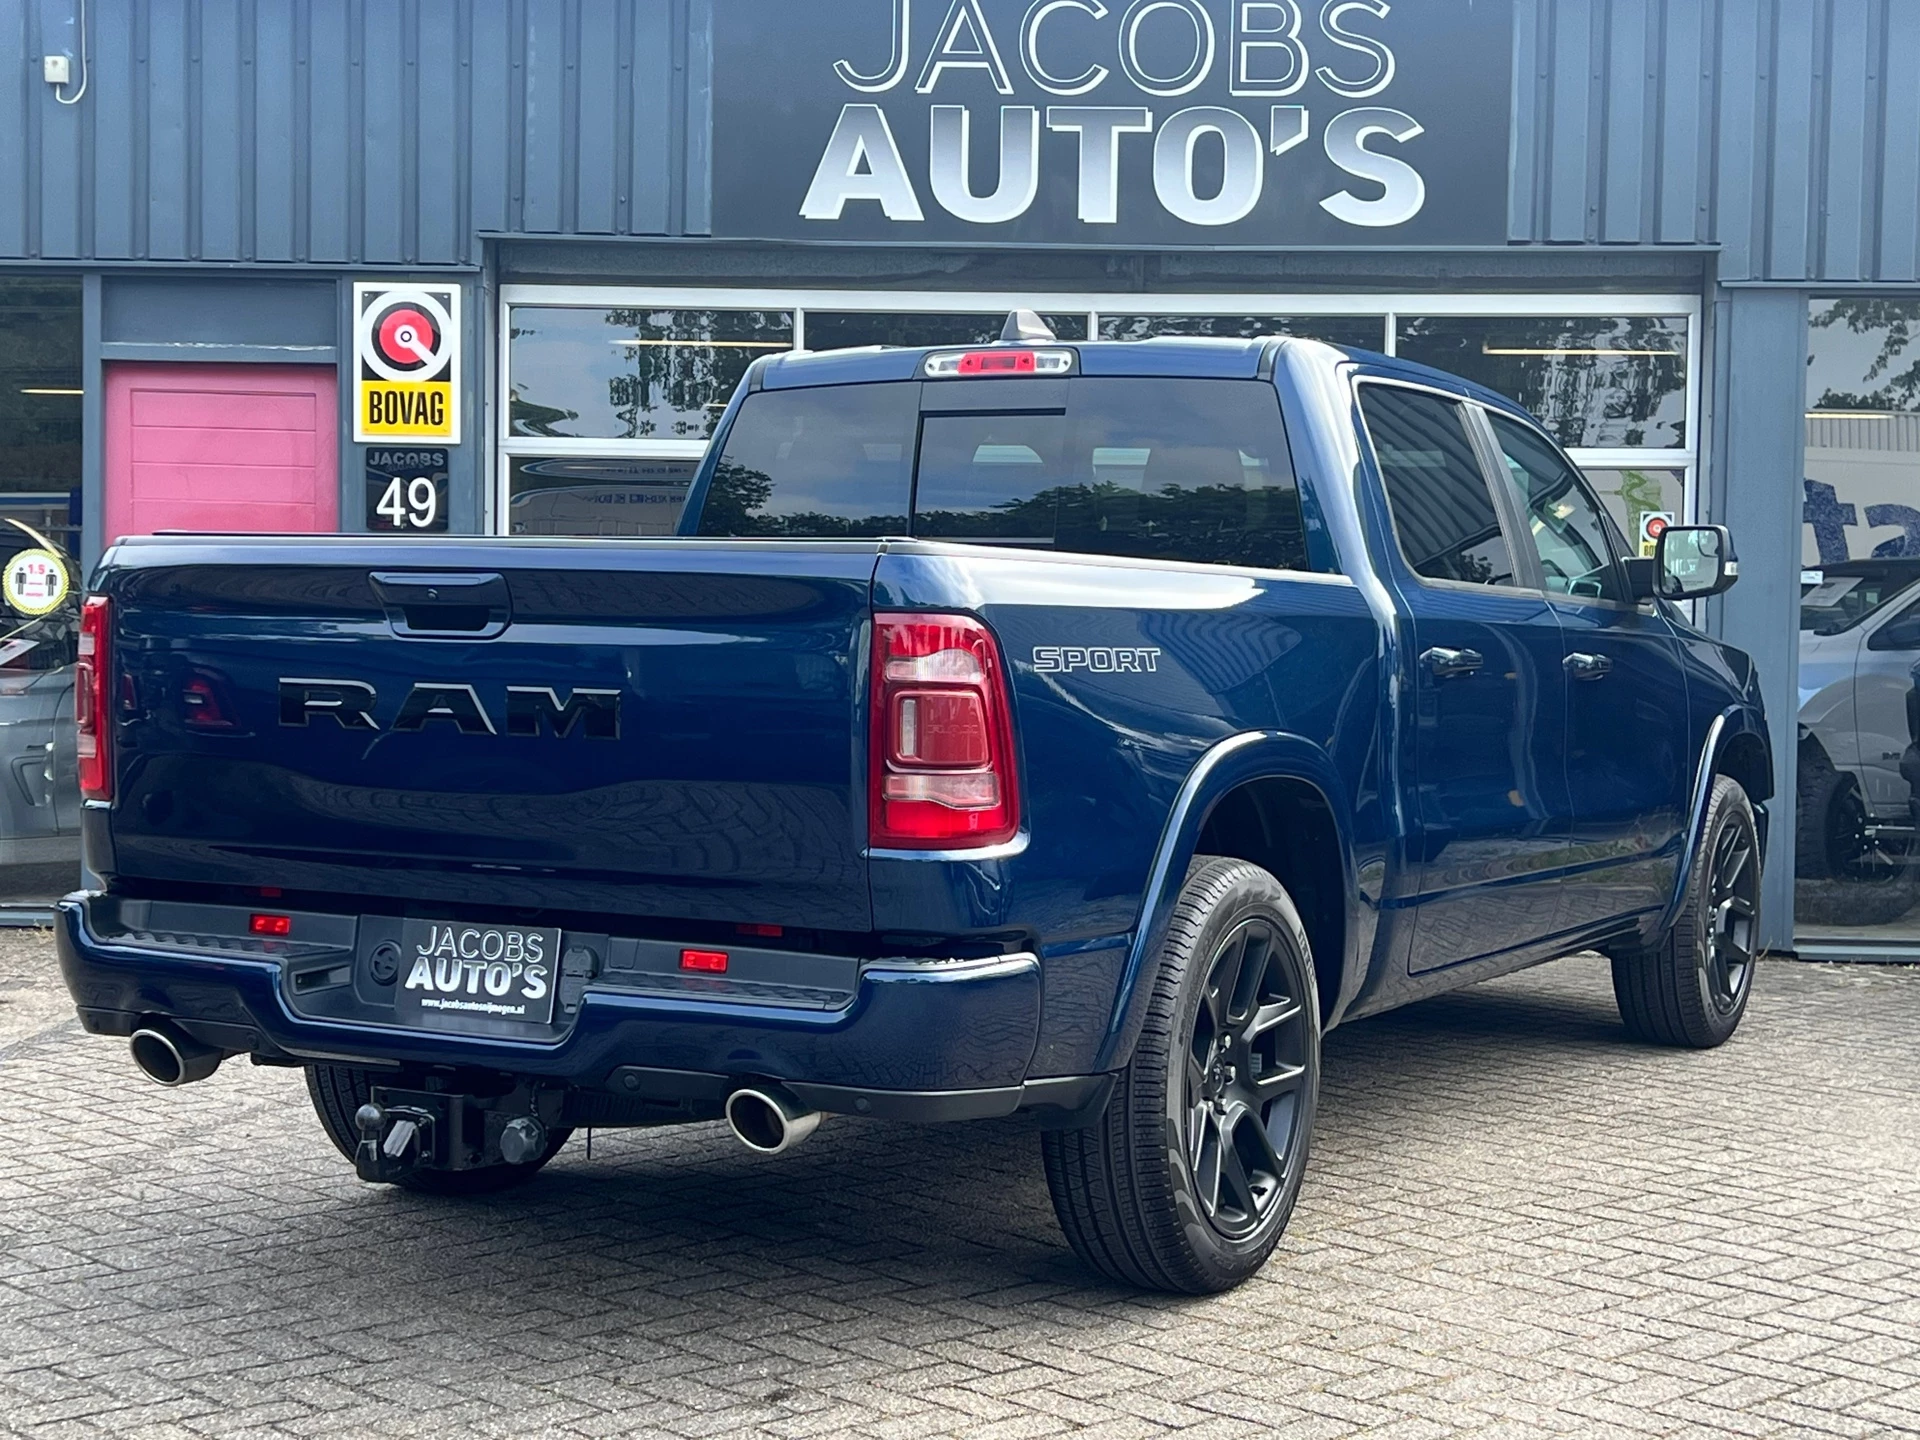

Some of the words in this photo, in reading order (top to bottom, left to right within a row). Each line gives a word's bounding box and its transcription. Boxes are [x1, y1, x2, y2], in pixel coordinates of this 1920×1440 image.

[833, 0, 1397, 97] JACOBS
[799, 103, 1425, 226] AUTO'S
[369, 390, 444, 426] BOVAG
[369, 451, 444, 467] JACOBS
[376, 477, 437, 528] 49
[28, 564, 46, 575] 1.5
[1033, 646, 1161, 673] SPORT
[278, 677, 621, 741] RAM
[416, 925, 544, 963] JACOBS
[404, 956, 548, 999] AUTO'S
